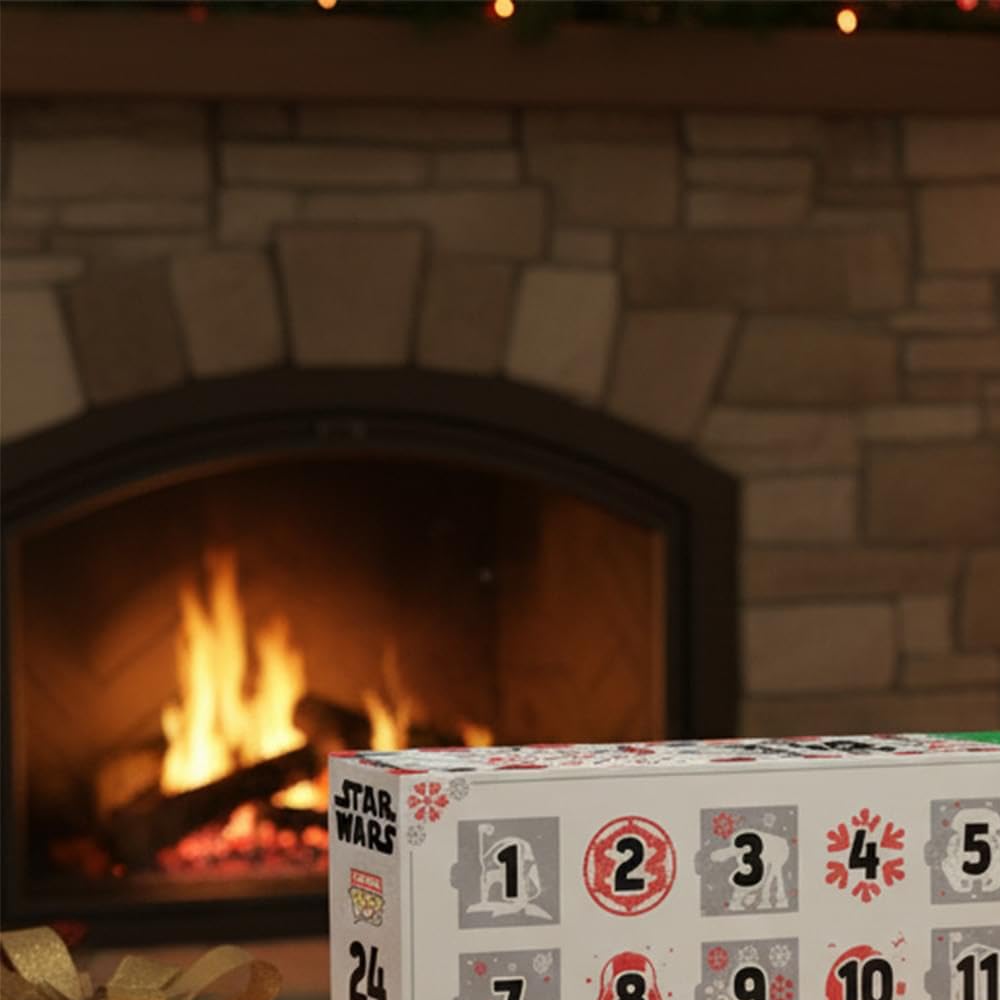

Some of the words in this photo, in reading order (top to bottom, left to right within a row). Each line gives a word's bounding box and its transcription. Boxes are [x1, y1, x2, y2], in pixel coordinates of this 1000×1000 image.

[334, 779, 397, 823] STAR
[335, 809, 397, 855] WARS
[849, 829, 880, 879] 4
[962, 823, 991, 875] 5
[497, 845, 518, 898] 1
[614, 837, 645, 892] 2
[733, 833, 764, 887] 3
